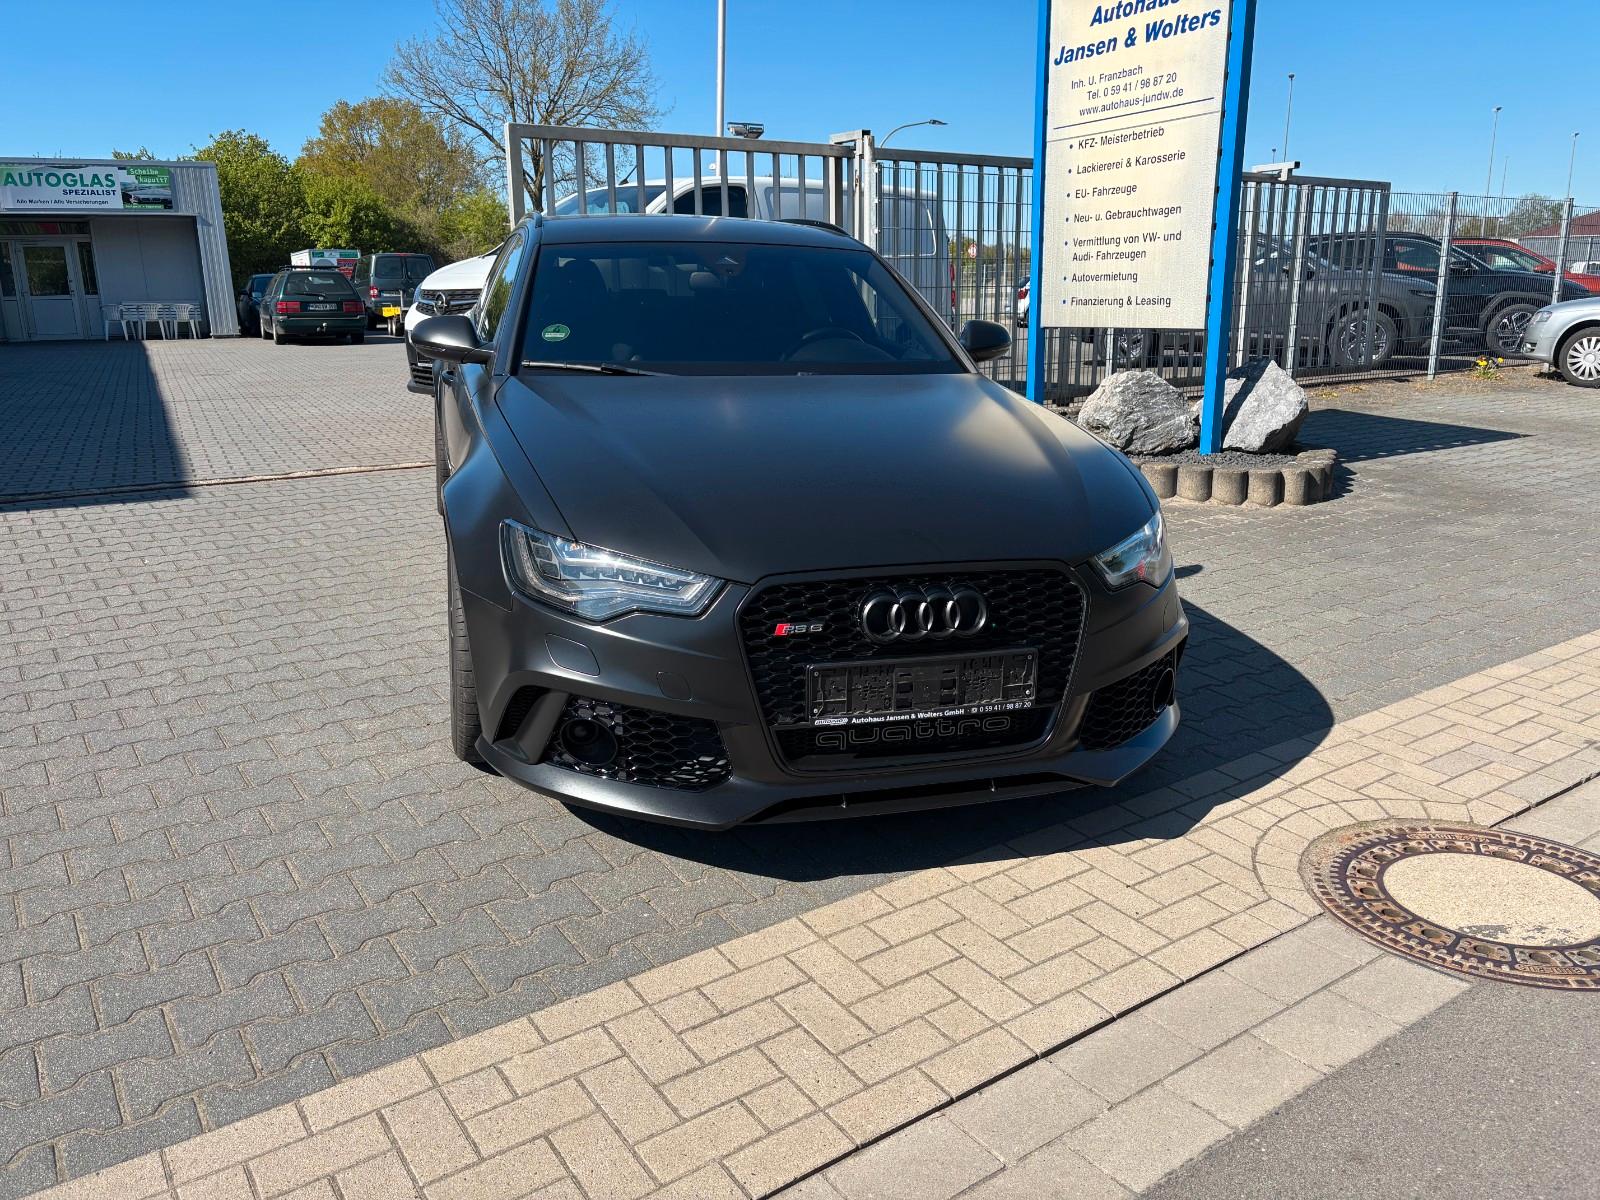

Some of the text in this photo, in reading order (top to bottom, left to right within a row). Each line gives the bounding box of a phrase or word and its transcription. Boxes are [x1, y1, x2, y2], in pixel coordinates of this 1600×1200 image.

[1054, 8, 1221, 65] Jansen & Wolters
[1071, 64, 1143, 90] Inh. U. Franzbach
[1087, 89, 1102, 101] Tel.
[1103, 87, 1109, 97] 0
[1110, 85, 1121, 96] 59
[1122, 82, 1133, 94] 41
[1140, 78, 1151, 90] 98
[1153, 75, 1164, 87] 87
[1166, 72, 1177, 84] 20
[1079, 87, 1184, 117] www.autohaus-jundw.de
[1078, 126, 1165, 150] KFZ- Meisterbetrieb
[1076, 150, 1186, 175] Lackiererei & Karosserie
[3, 171, 116, 188] AUTOGLAS
[1075, 183, 1138, 199] EU- Fahrzeuge
[1073, 205, 1182, 223] Neu- u. Gebrauchtwagen
[1073, 231, 1182, 248] Vermittlung von VW- und
[1072, 248, 1147, 262] Audi- Fahrzeugen
[1071, 271, 1138, 283] Autovermietung
[1070, 295, 1172, 308] Finanzierung & Leasing
[851, 715, 885, 724] Autohaus
[886, 713, 910, 722] Jansen
[917, 710, 944, 719] Wolters
[944, 708, 965, 716] GmbH
[815, 716, 1011, 751] quattro
